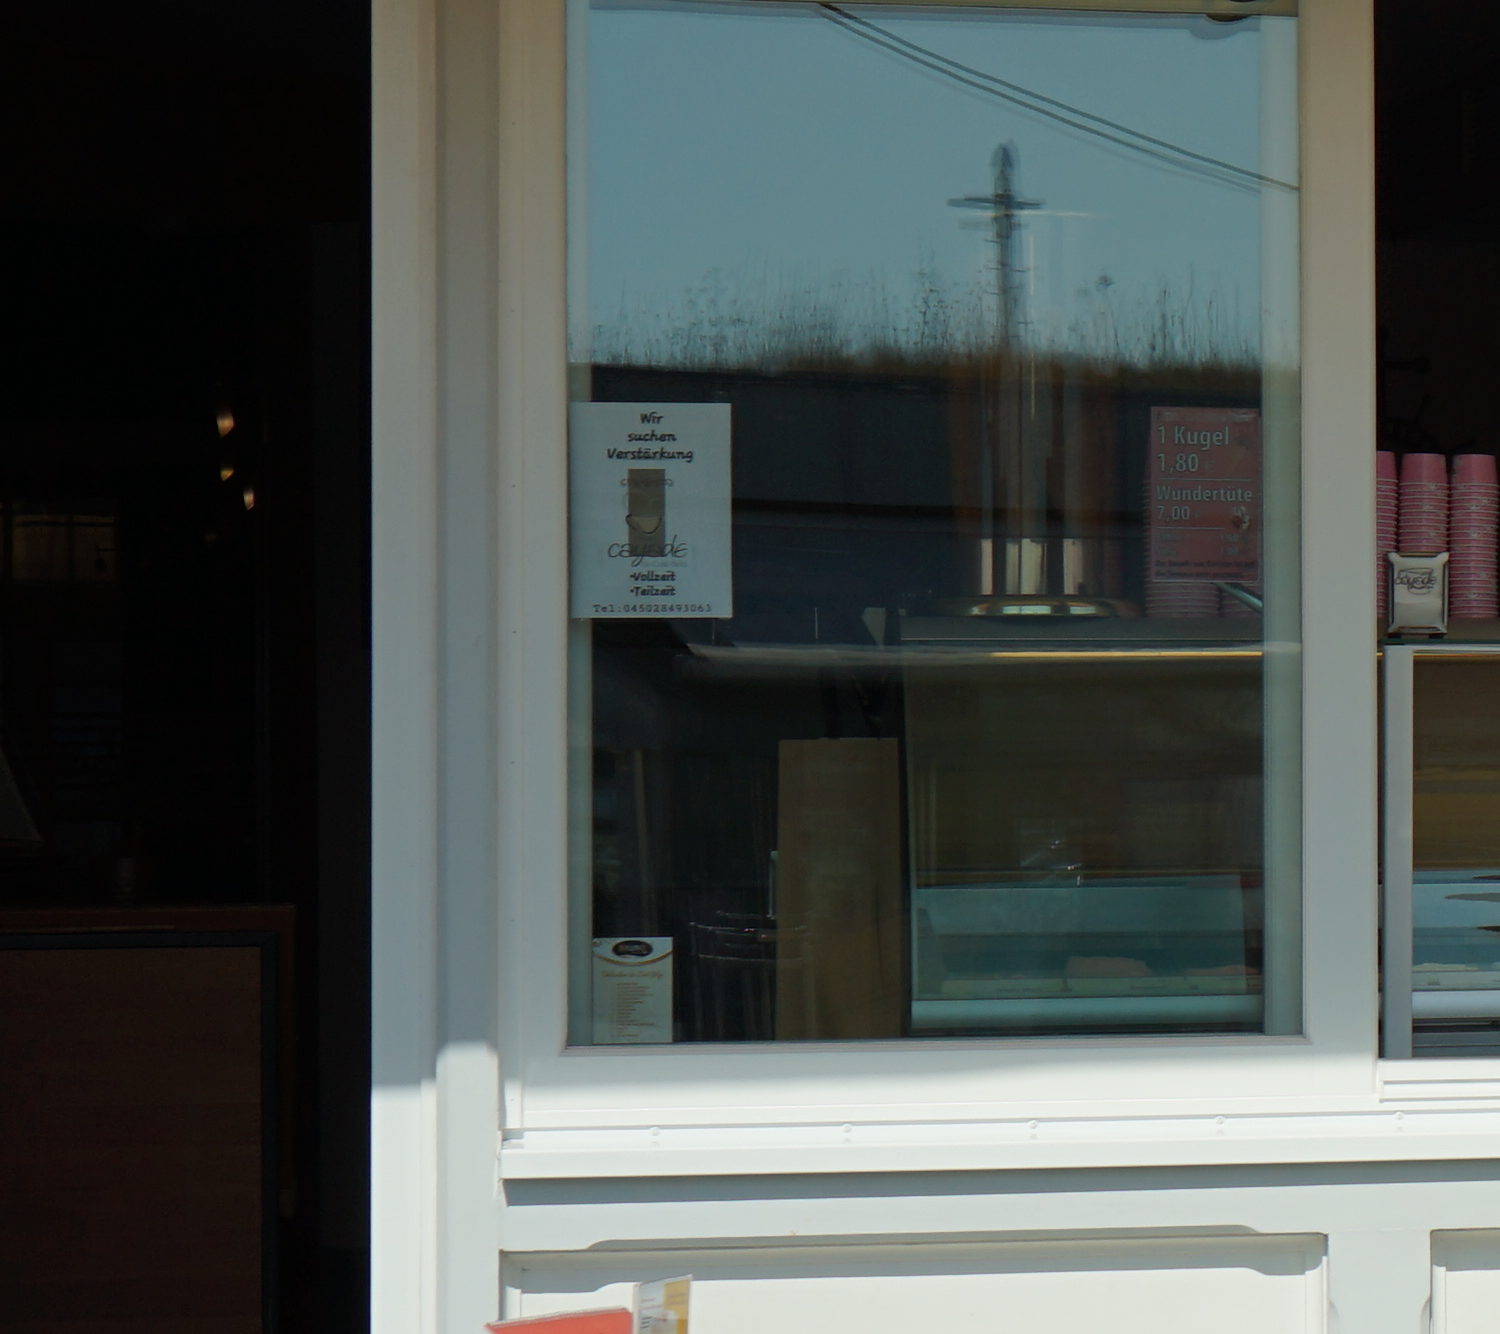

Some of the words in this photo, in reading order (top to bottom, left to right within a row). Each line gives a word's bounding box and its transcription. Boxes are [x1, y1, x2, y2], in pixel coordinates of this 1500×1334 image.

[640, 412, 664, 425] Wir
[627, 430, 677, 443] suchen
[1158, 426, 1166, 445] 1
[1174, 425, 1230, 451] Kugel
[607, 448, 694, 464] Verstärkung
[1158, 453, 1200, 475] 1,80
[1157, 485, 1253, 502] Wundertüte
[1157, 505, 1191, 523] 7,00
